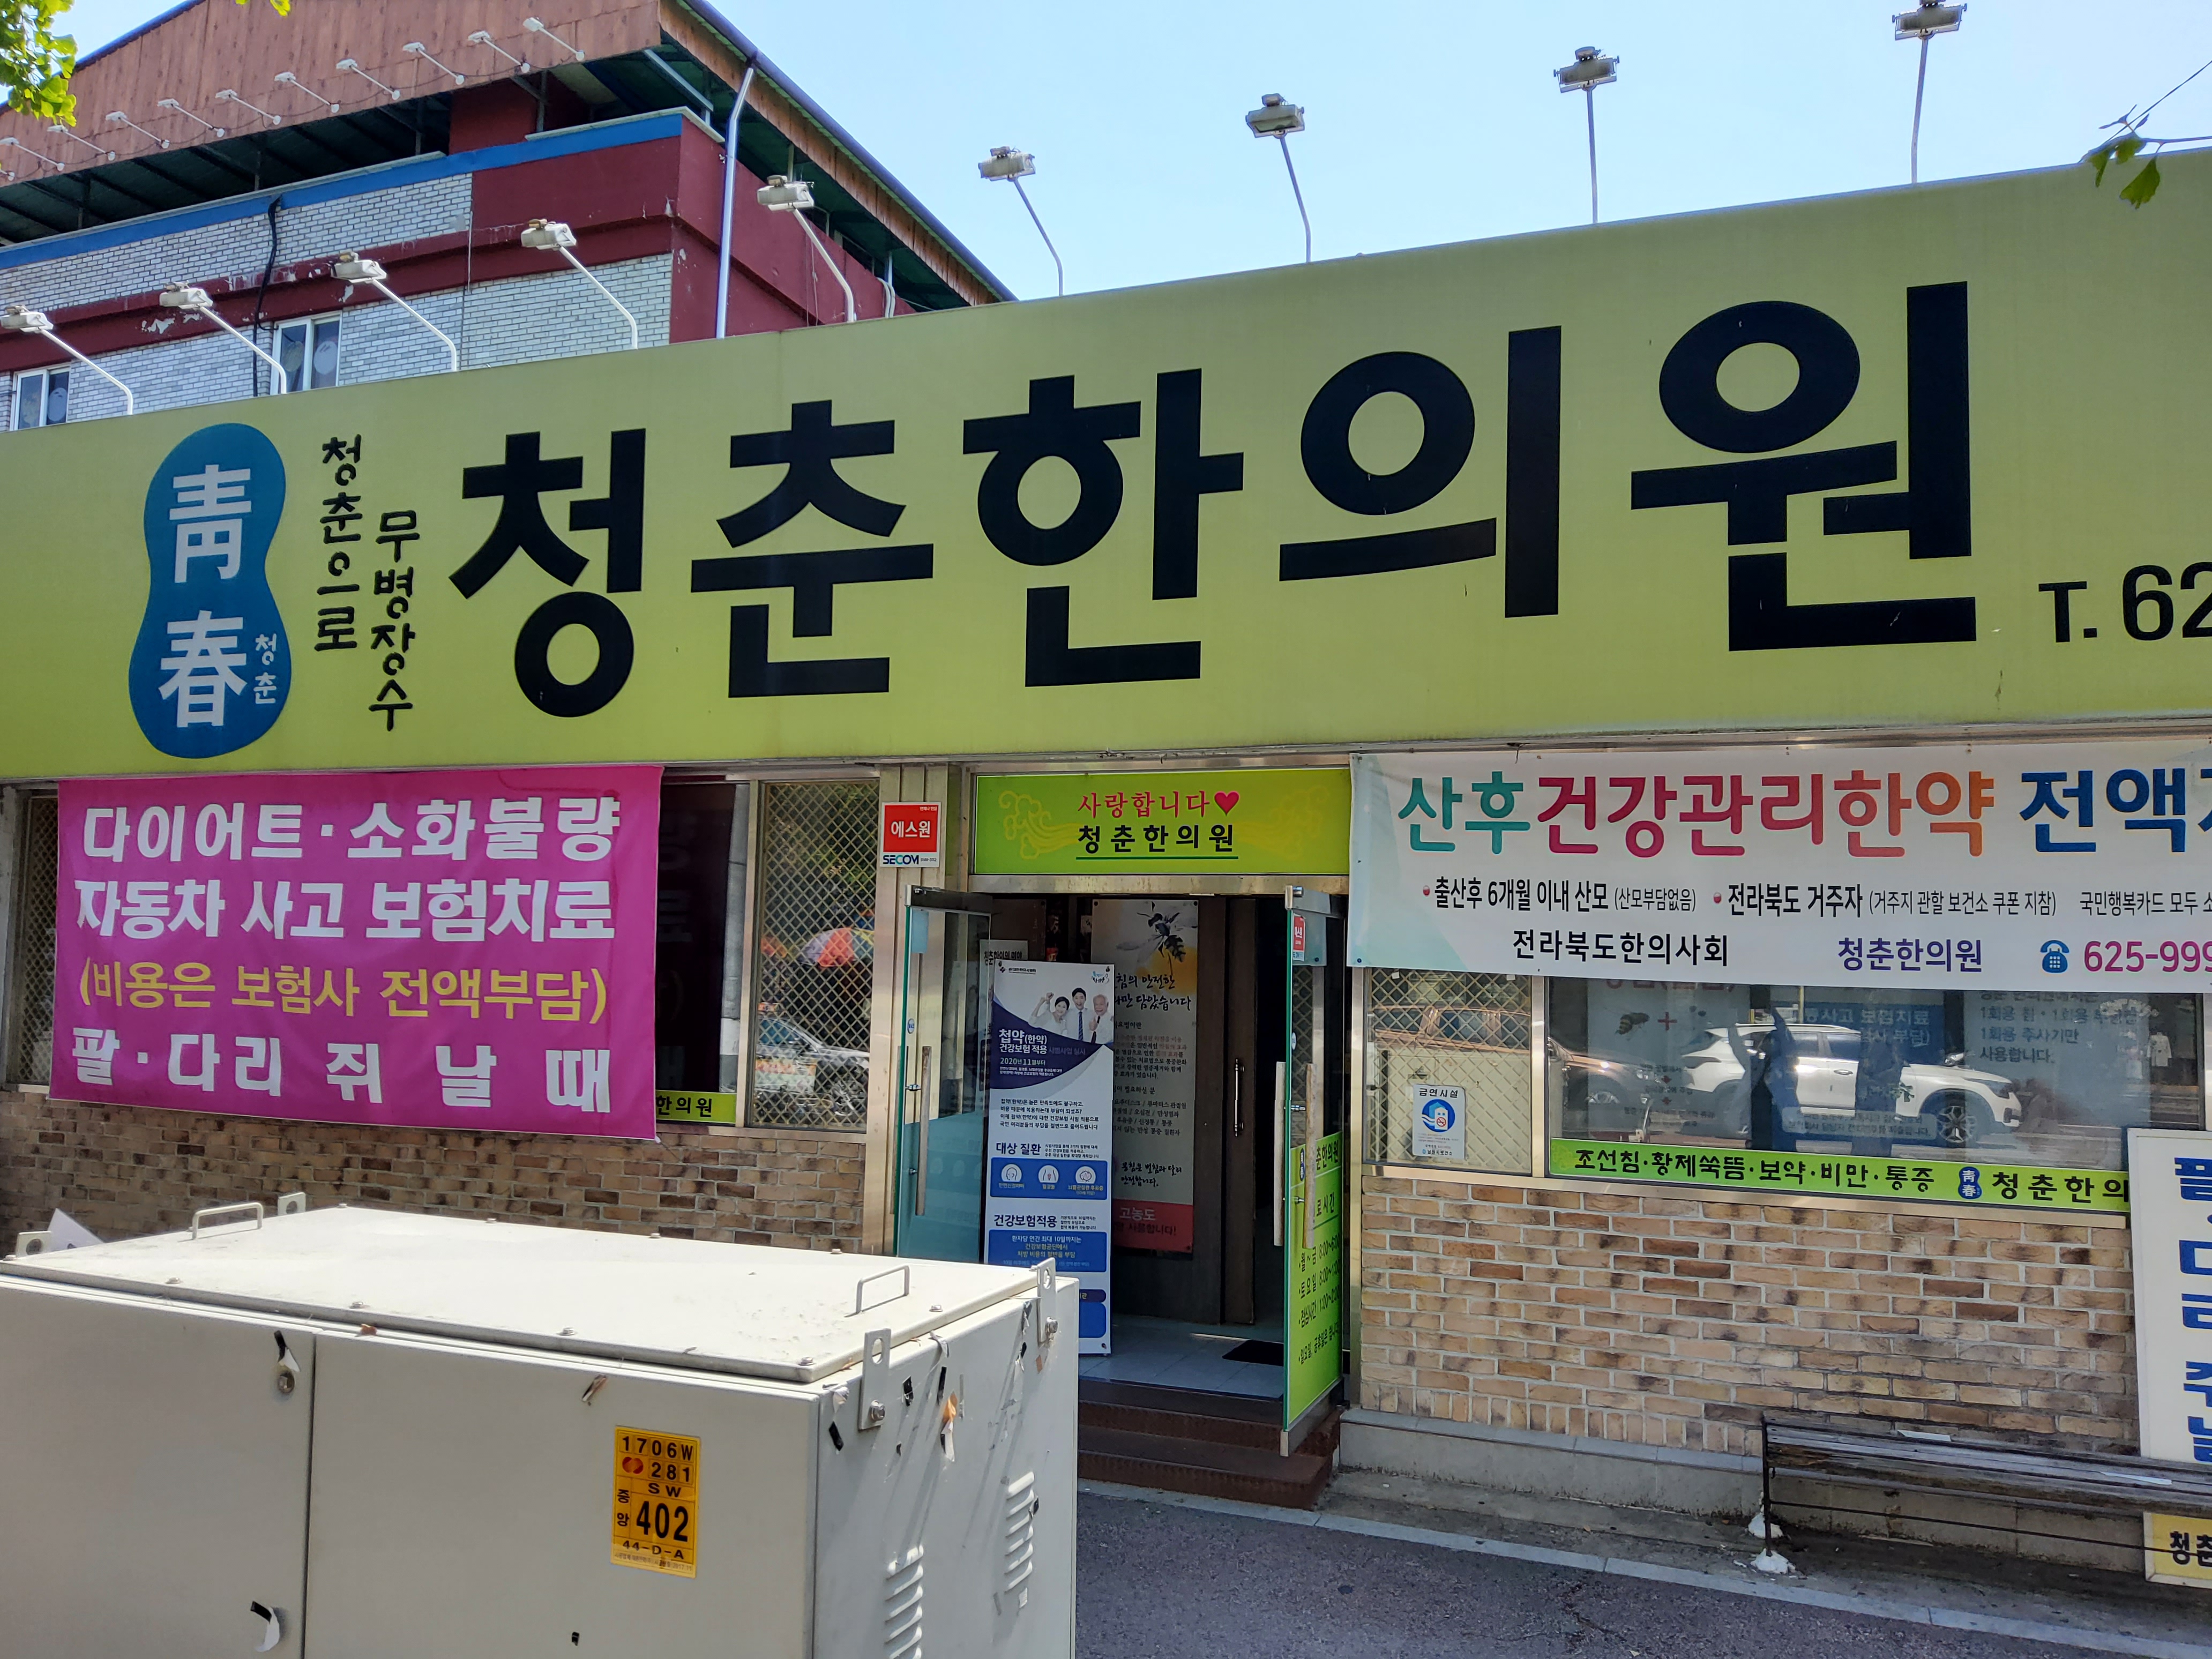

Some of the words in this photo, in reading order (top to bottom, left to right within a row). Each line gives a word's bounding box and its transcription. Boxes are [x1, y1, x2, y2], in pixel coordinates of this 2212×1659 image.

[449, 281, 1976, 718] 청춘한의원
[314, 434, 363, 652] 청춘으로
[368, 510, 420, 732] 무병장수
[2038, 581, 2097, 642] T.
[253, 634, 277, 705] 청춘
[1077, 790, 1210, 819] 사랑합니다
[2019, 768, 2212, 853] 전액
[891, 820, 931, 838] 에스원
[1078, 824, 1233, 854] 청춘한의원
[883, 854, 920, 865] SECOM
[1434, 876, 1483, 909] 출산후
[1488, 879, 1531, 911] 6개월
[1537, 879, 1570, 912] 이내
[1574, 880, 1609, 912] 산모
[1615, 887, 1697, 913] (산모부담없음)
[1728, 883, 1802, 917] 전라북도
[1807, 884, 1864, 918] 거주자
[1869, 890, 1913, 915] (거주지
[1917, 890, 1945, 915] 관할
[1948, 891, 1989, 915] 보건소
[1992, 892, 2020, 915] 쿠폰
[2024, 891, 2057, 916] 지참)
[2080, 891, 2166, 916] 국민행복카드
[2170, 892, 2199, 915] 모두
[74, 879, 225, 939] 자동차
[241, 880, 344, 940] 사고
[366, 878, 615, 942] 보험치료
[1513, 929, 1729, 967] 전라북도한의사회
[1838, 938, 1983, 973] 청춘한의원
[80, 957, 215, 1008] (비용은
[232, 965, 360, 1017] 보험사
[380, 968, 607, 1024] 전액부담)
[1115, 973, 1138, 991] 침의
[1142, 973, 1176, 991] 안전한
[1136, 993, 1192, 1012] 담았습니다
[999, 1029, 1048, 1045] 첩약(한약)
[999, 1044, 1030, 1055] 건강보험
[1031, 1045, 1048, 1055] 적용
[1000, 1057, 1022, 1066] 2020년
[655, 1095, 712, 1118] 한의원
[1419, 1088, 1459, 1098] 금연시설
[995, 1142, 1018, 1155] 대상
[1020, 1143, 1042, 1155] 질환
[1316, 1140, 1339, 1171] 춘한의원
[993, 1215, 1058, 1228] 건강보험적용
[1119, 1207, 1157, 1222] 고농도
[622, 1436, 693, 1461] 1706W
[651, 1461, 690, 1483] 281
[617, 1489, 630, 1527] 중앙
[636, 1501, 689, 1543] 402
[622, 1540, 684, 1560] 44-D-A
